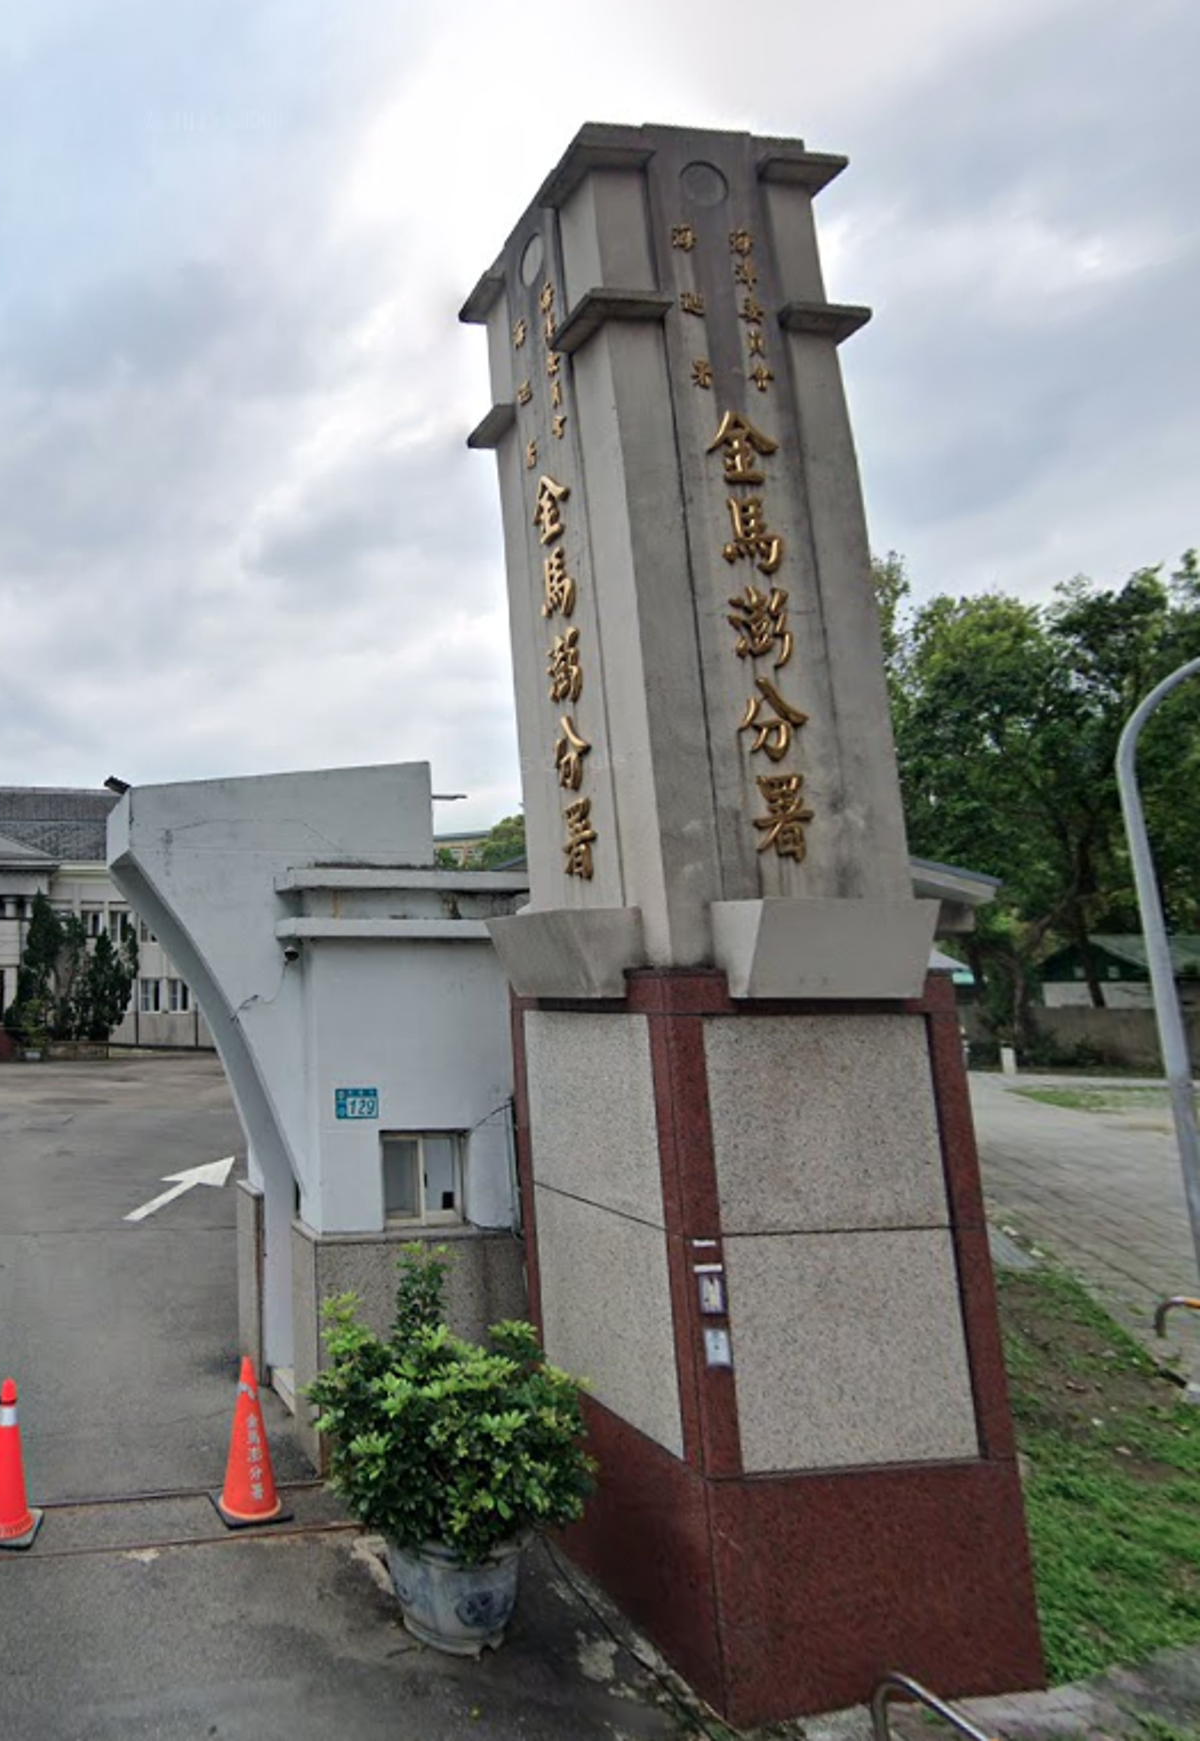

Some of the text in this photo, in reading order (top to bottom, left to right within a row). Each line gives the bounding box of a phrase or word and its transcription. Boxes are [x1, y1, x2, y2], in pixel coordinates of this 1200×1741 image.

[532, 473, 599, 882] 金馬澎分署
[706, 409, 815, 864] 金馬澎分署
[349, 1099, 376, 1115] 129
